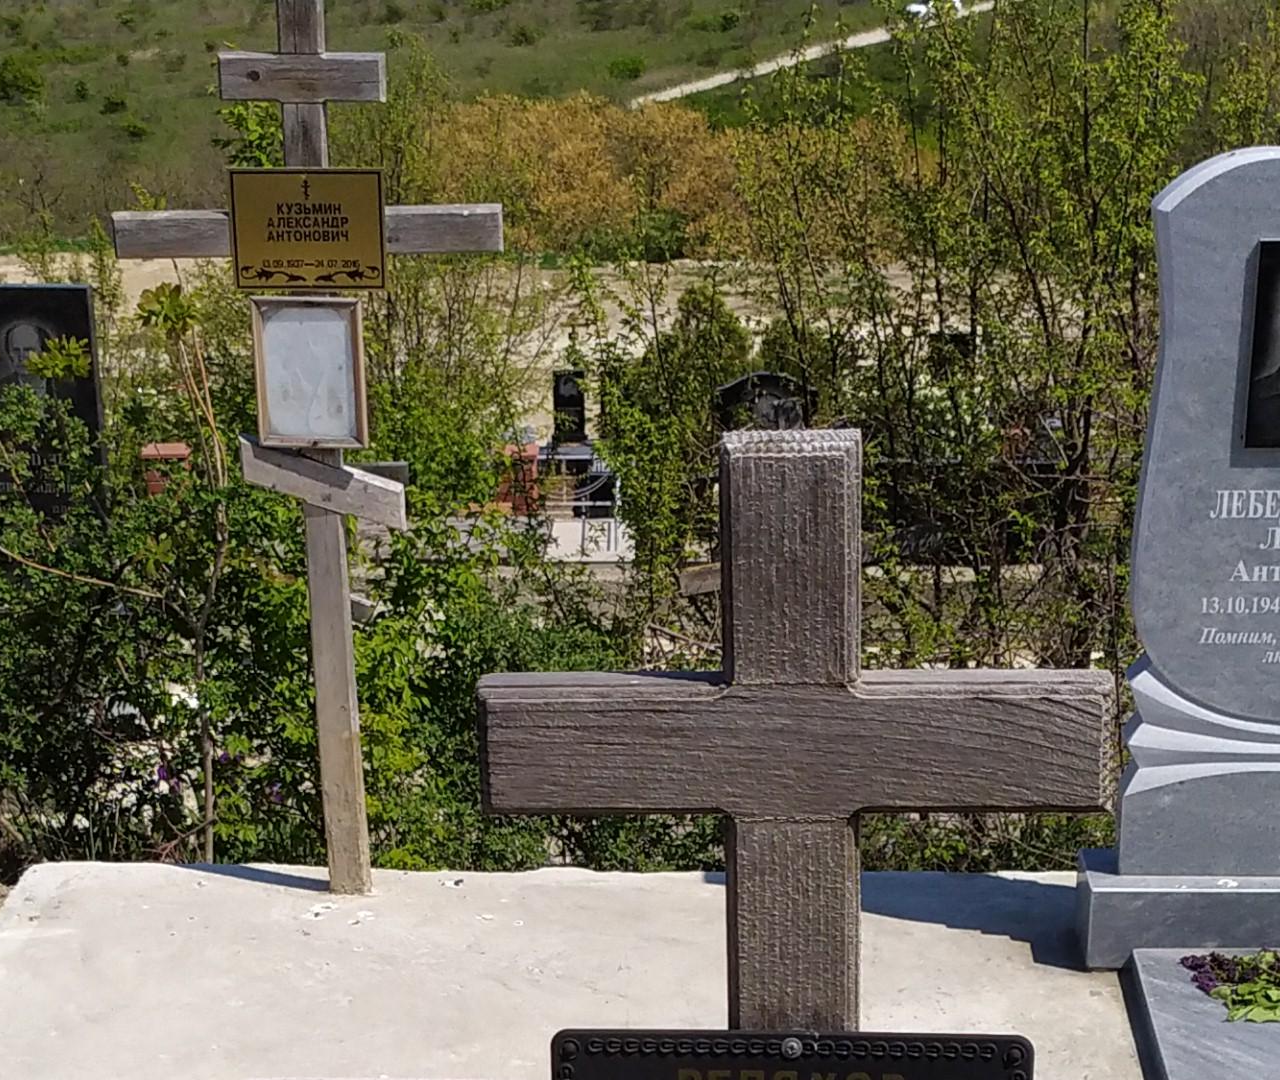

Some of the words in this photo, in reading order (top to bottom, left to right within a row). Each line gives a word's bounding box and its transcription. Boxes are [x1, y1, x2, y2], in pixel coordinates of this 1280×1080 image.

[276, 202, 342, 216] КУЗЬМИН
[267, 216, 349, 229] АЛЕКСАНДР
[266, 230, 349, 242] АНТОНОВИЧ
[1199, 627, 1277, 646] Помним,
